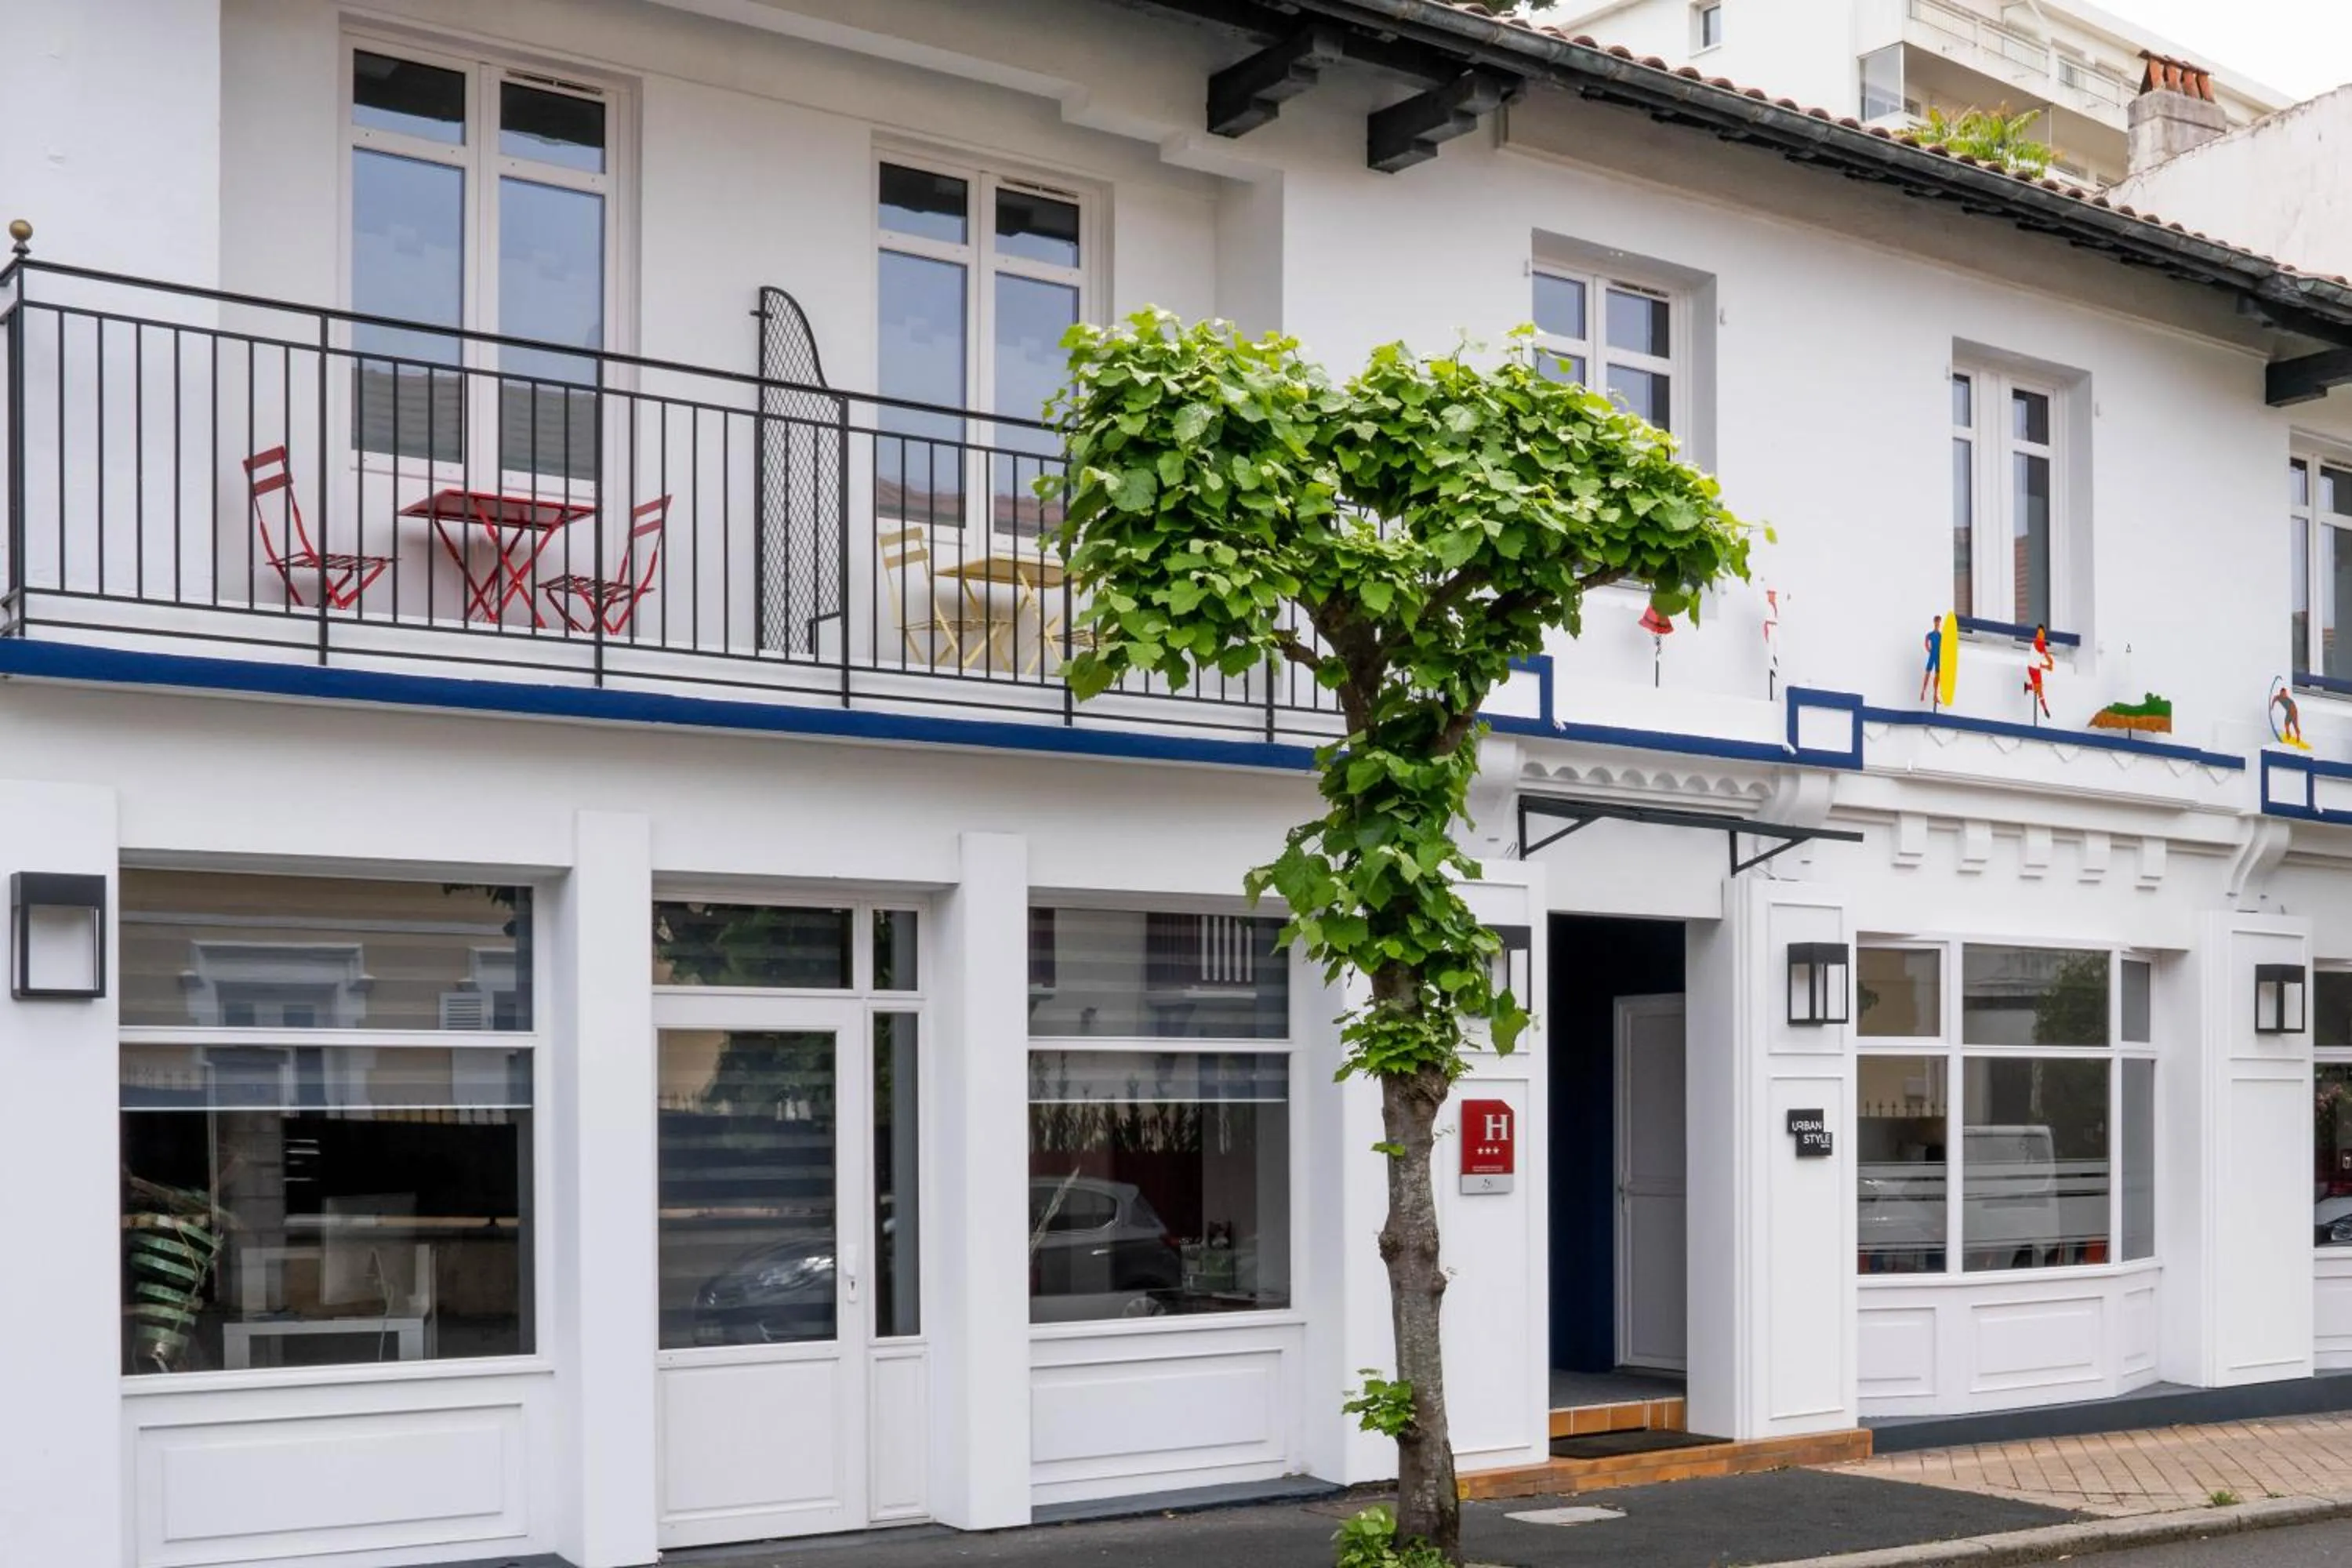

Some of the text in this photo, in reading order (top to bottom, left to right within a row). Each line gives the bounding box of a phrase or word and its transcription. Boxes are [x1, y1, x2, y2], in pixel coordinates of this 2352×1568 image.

[1484, 1114, 1510, 1141] H
[1791, 1120, 1822, 1131] URBAN
[1803, 1134, 1831, 1144] STYLE
